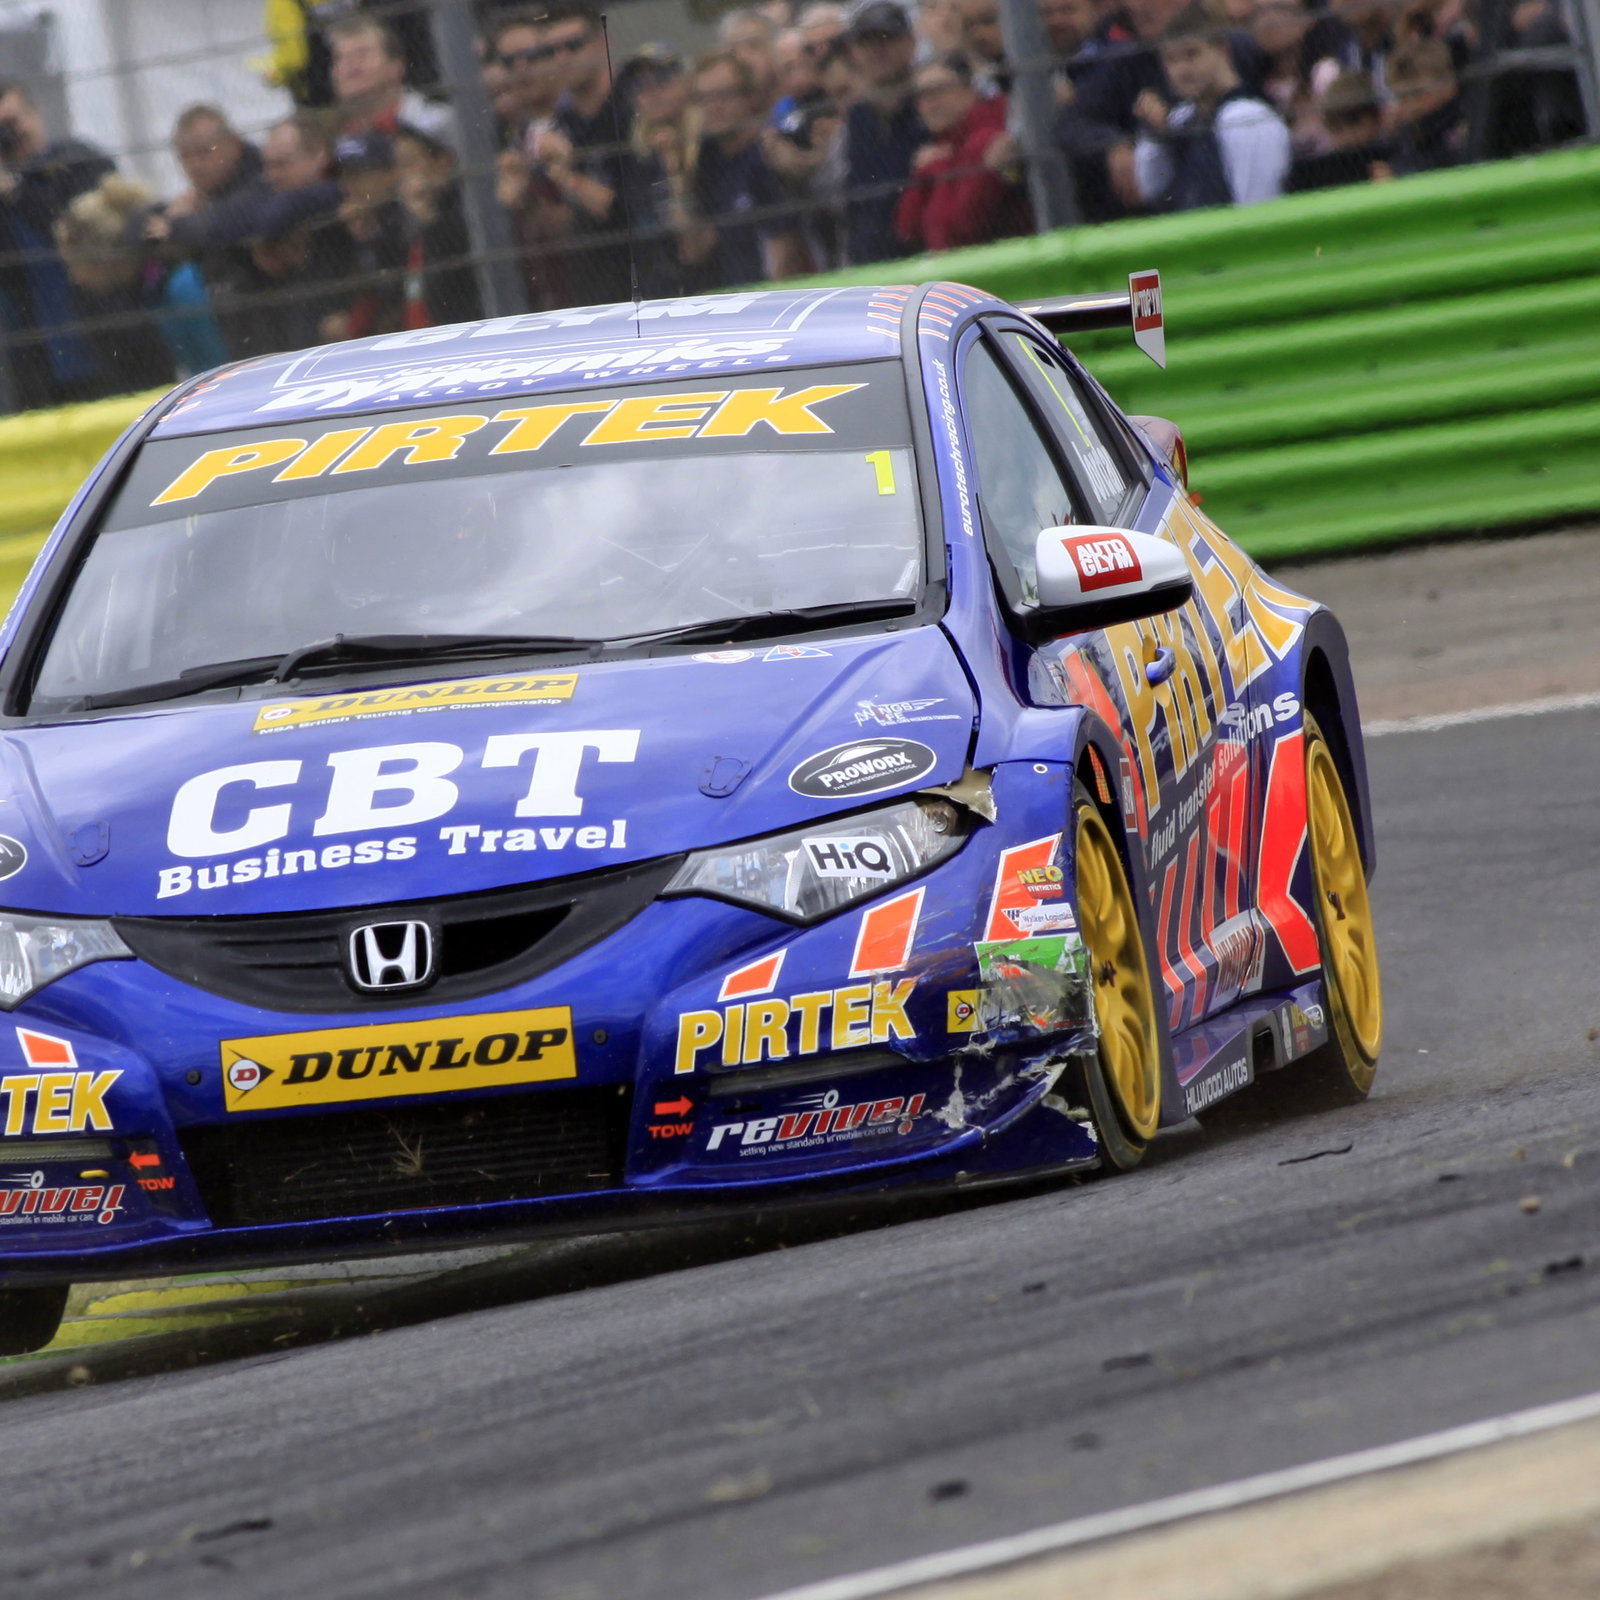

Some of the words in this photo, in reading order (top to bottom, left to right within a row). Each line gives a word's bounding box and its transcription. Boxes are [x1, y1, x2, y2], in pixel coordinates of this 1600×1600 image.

[374, 377, 545, 403] ALLOY
[583, 354, 793, 380] WHEELS
[149, 382, 871, 507] PIRTEK
[931, 358, 975, 537] eurotechracing.co.uk
[864, 450, 897, 496] 1
[1075, 538, 1128, 560] AUTO
[1080, 551, 1135, 577] GLYM
[298, 715, 351, 730] British
[355, 708, 413, 722] Touring
[416, 704, 446, 714] Car
[449, 699, 562, 711] Championship
[309, 679, 574, 713] DUNLOP
[817, 751, 913, 788] PROWORX
[1150, 808, 1176, 870] fluid
[1178, 759, 1217, 834] transfer
[1218, 691, 1301, 777] solutions
[167, 729, 640, 858] CBT
[157, 836, 417, 899] Business
[439, 819, 627, 856] Travel
[809, 840, 891, 874] HiQ
[1016, 864, 1065, 885] NEO
[674, 975, 920, 1075] PIRTEK
[281, 1027, 568, 1086] DUNLOP
[1223, 1056, 1249, 1094] AUTOS
[648, 1121, 694, 1139] TOW
[739, 1143, 767, 1157] setting
[768, 1142, 785, 1153] new
[786, 1134, 825, 1150] standards
[835, 1129, 863, 1143] mobile
[137, 1176, 176, 1191] TOW
